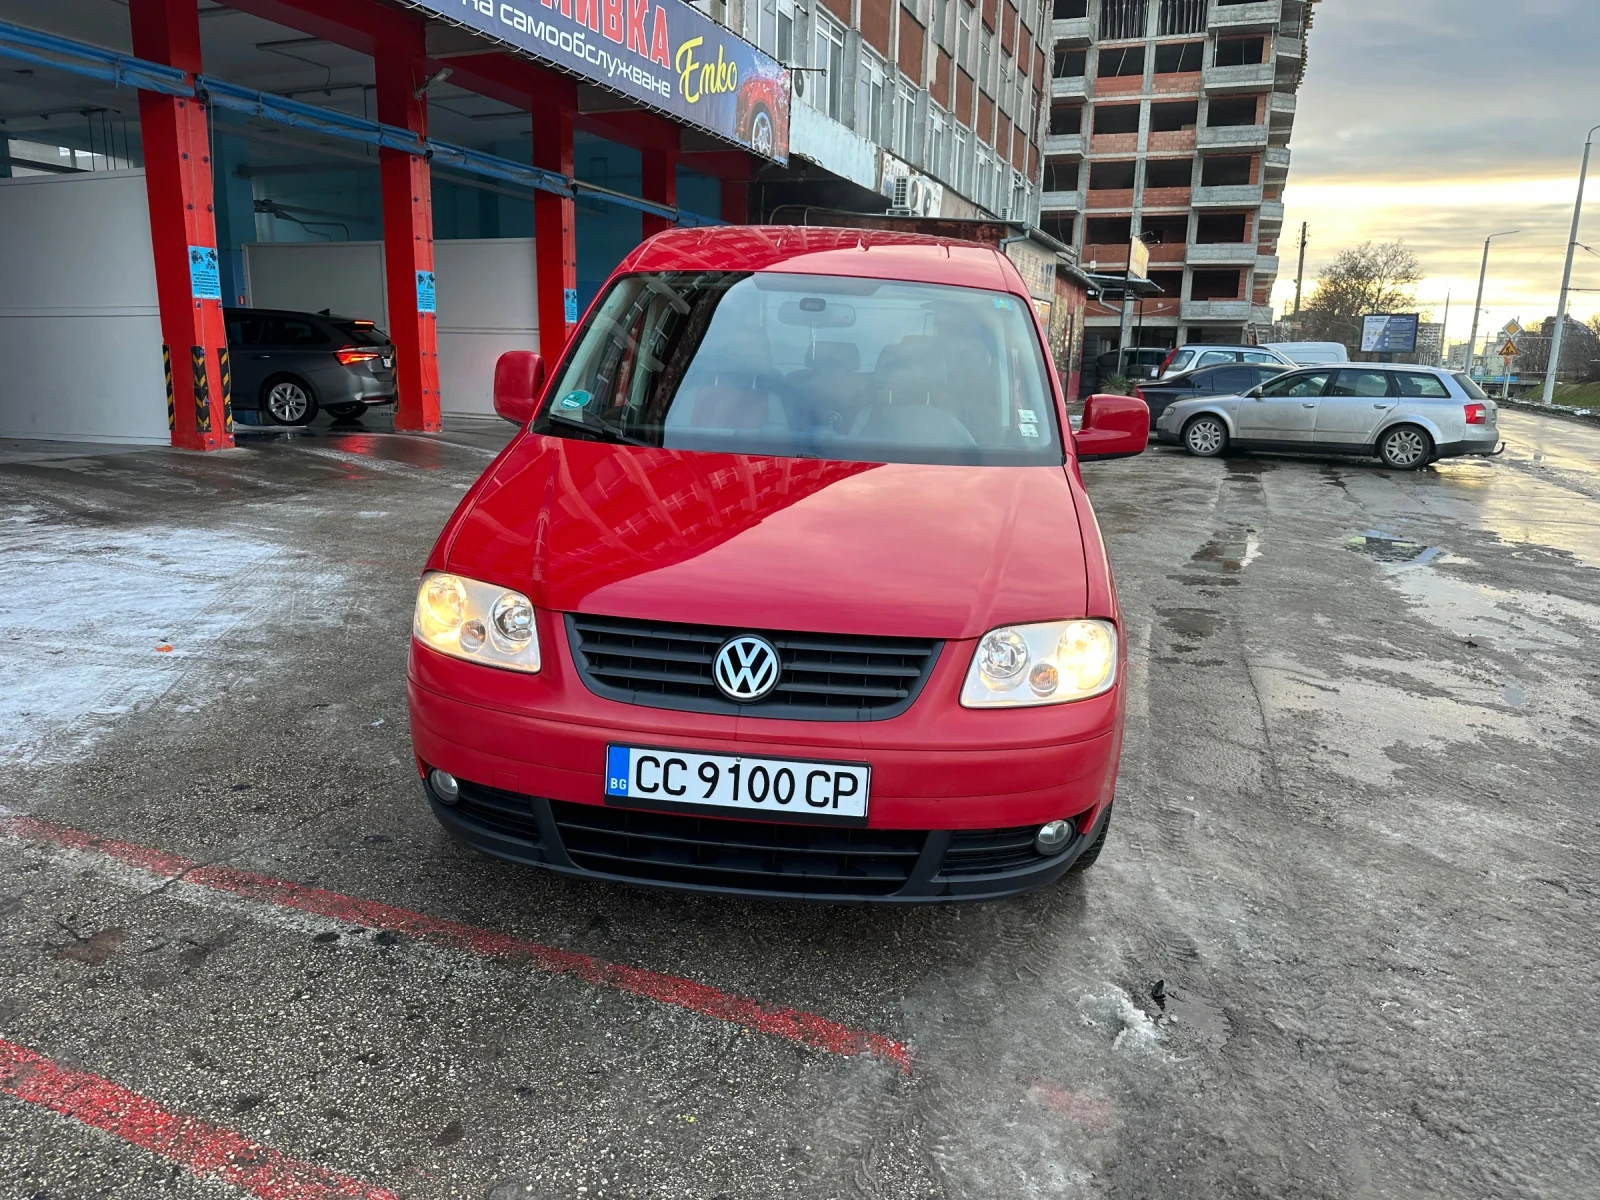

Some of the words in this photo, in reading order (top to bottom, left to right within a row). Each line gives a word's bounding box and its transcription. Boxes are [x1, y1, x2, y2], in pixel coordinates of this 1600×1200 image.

[500, 3, 671, 99] самообслужване
[541, 0, 671, 70] ВКА
[610, 777, 627, 790] BG
[636, 755, 688, 796] CC
[697, 761, 796, 805] 9100
[805, 769, 859, 809] CP
